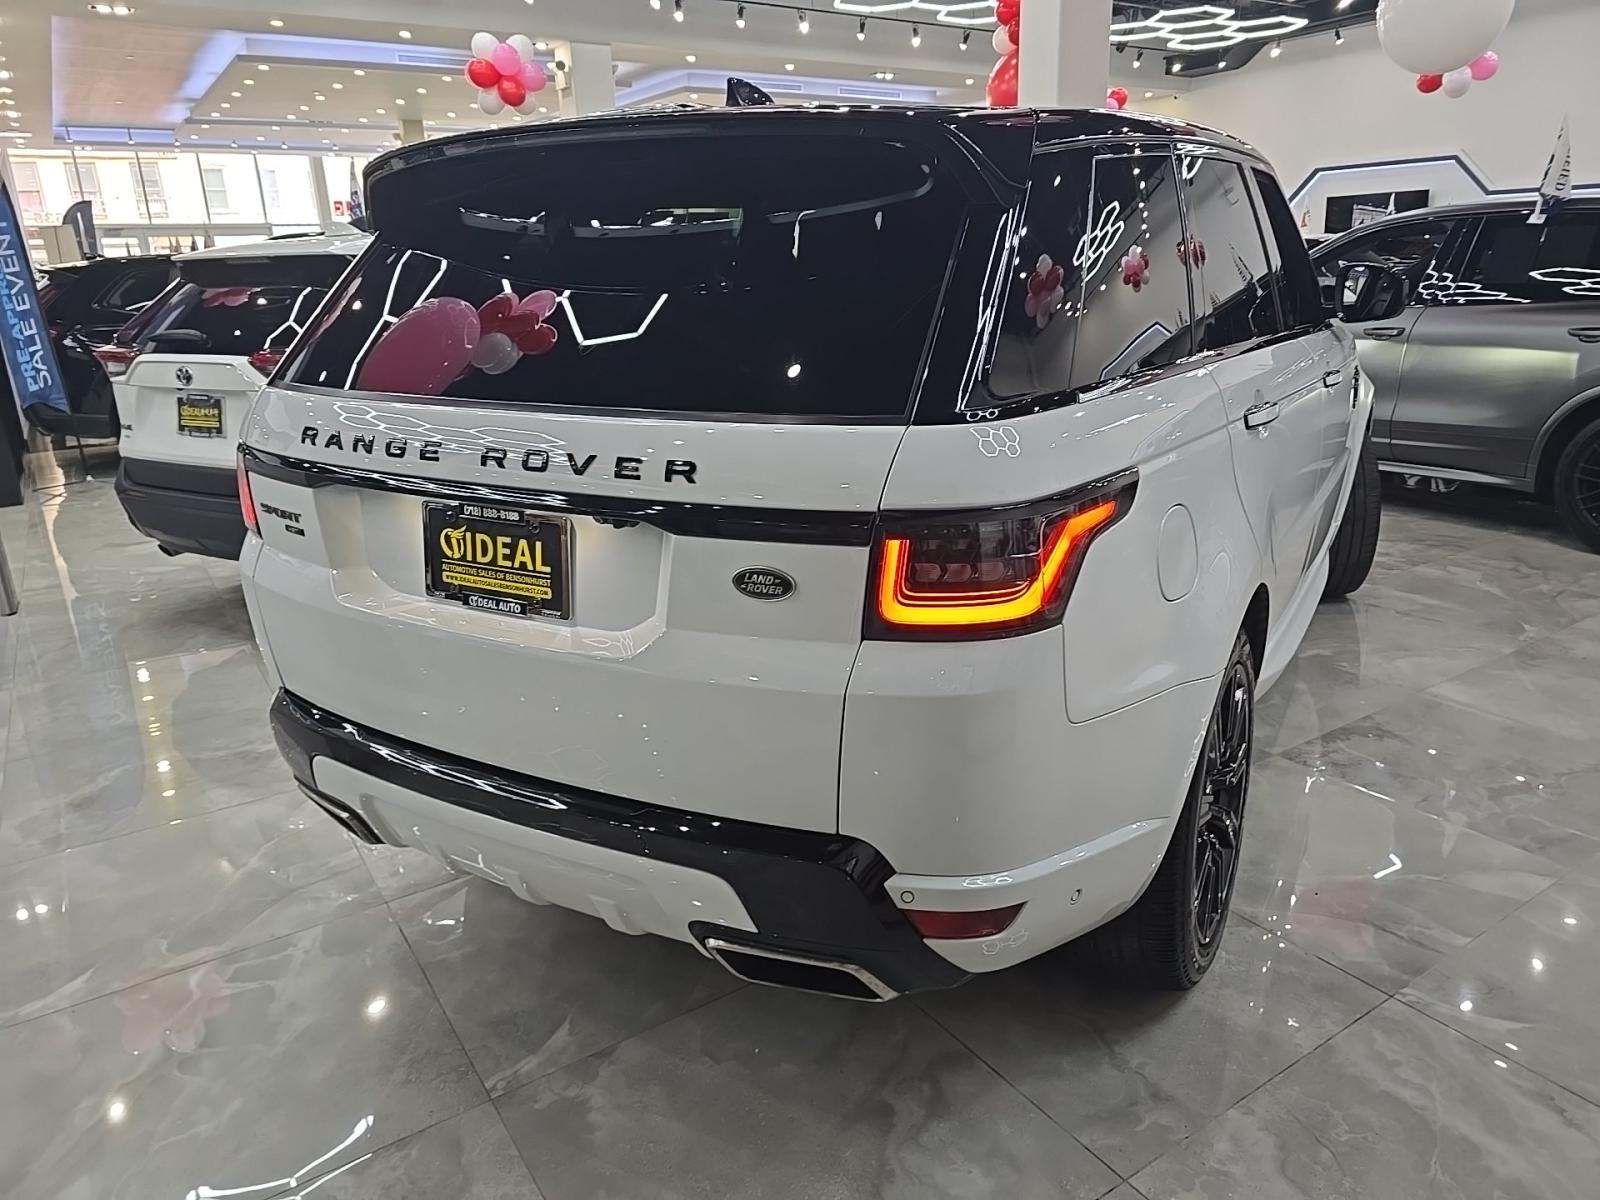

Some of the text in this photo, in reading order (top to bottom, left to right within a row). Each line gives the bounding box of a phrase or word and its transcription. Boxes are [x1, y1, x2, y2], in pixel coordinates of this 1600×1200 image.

[19, 317, 52, 389] SALE
[301, 426, 698, 484] RANGE ROVER
[465, 531, 552, 573] IDEAL
[442, 563, 552, 587] AUTOMOTIVE SALES OF BENSONHURST
[743, 572, 774, 585] LAND
[746, 583, 783, 595] ROVER
[498, 601, 521, 613] AUTO
